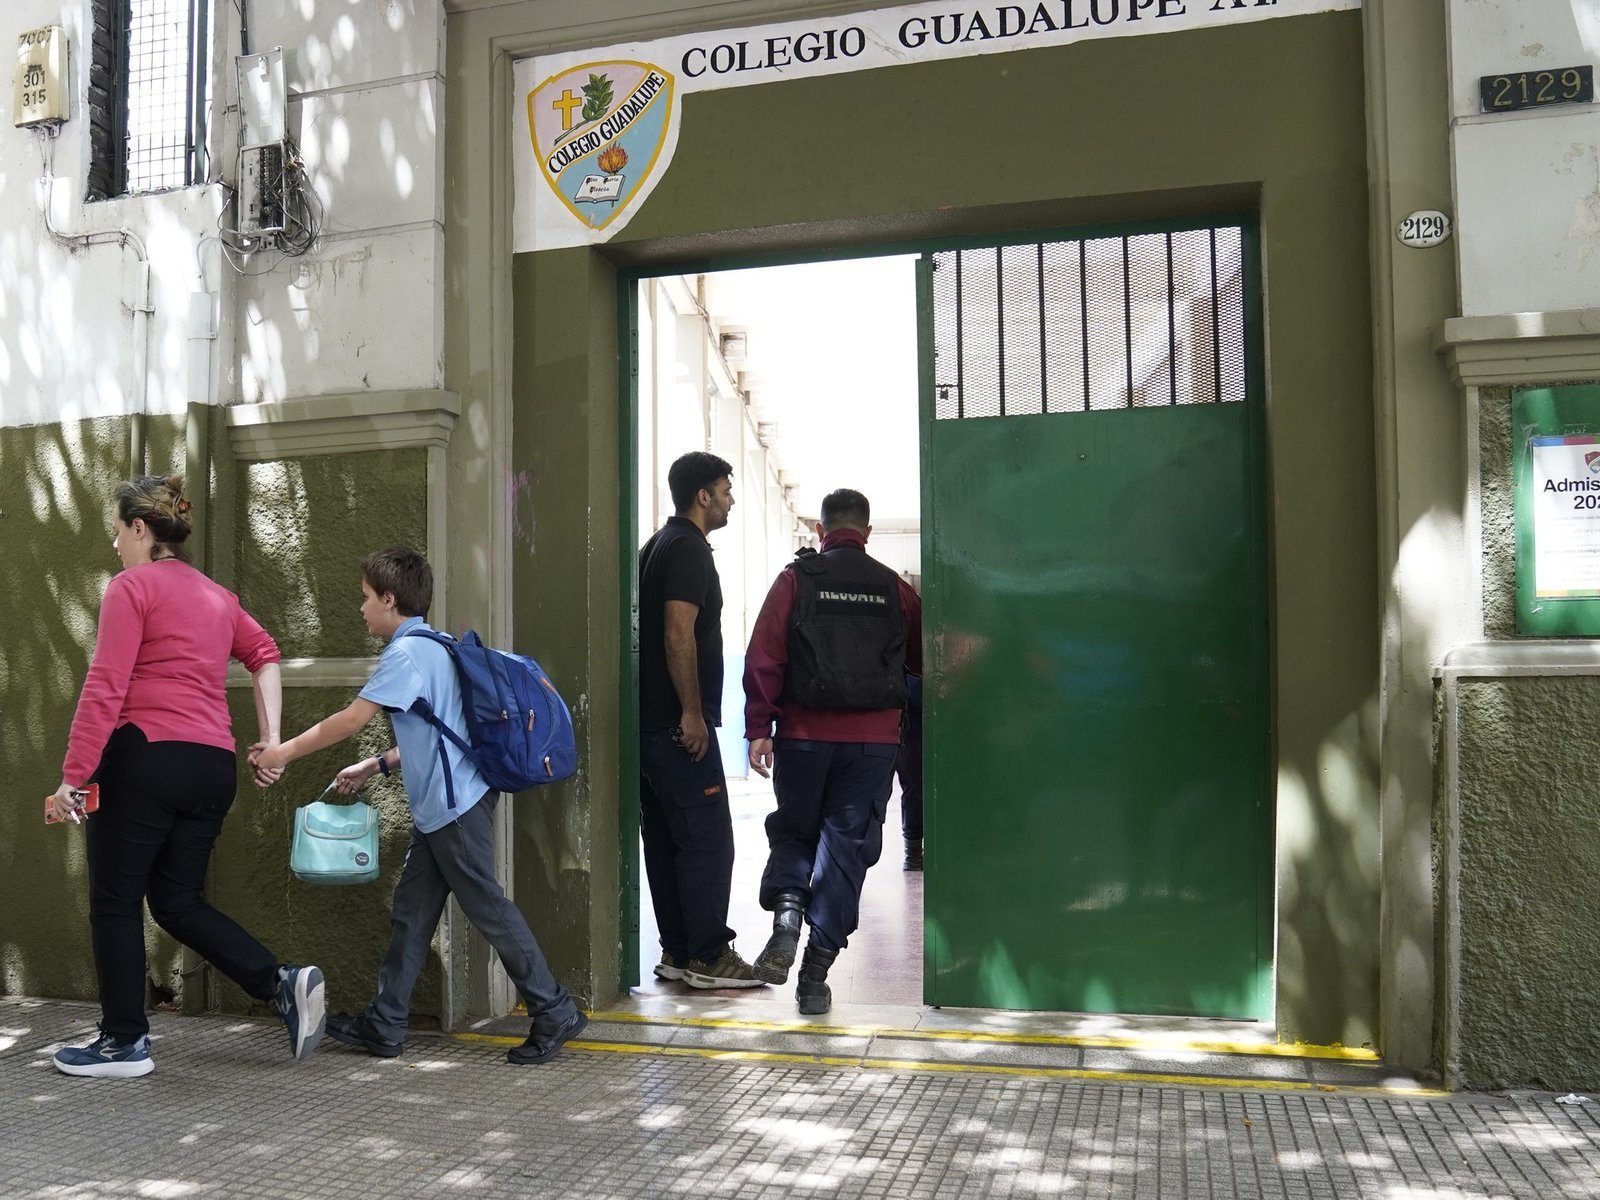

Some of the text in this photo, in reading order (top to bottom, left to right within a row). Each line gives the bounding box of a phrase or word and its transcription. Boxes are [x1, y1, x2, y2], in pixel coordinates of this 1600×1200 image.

[681, 0, 1186, 77] COLEGIO GUADALUPE
[23, 70, 46, 88] 301
[1492, 69, 1582, 107] 2129
[23, 88, 46, 107] 315
[548, 72, 666, 174] COLEGIO GUADALUPE
[1403, 216, 1444, 240] 2129
[1573, 495, 1600, 509] 20
